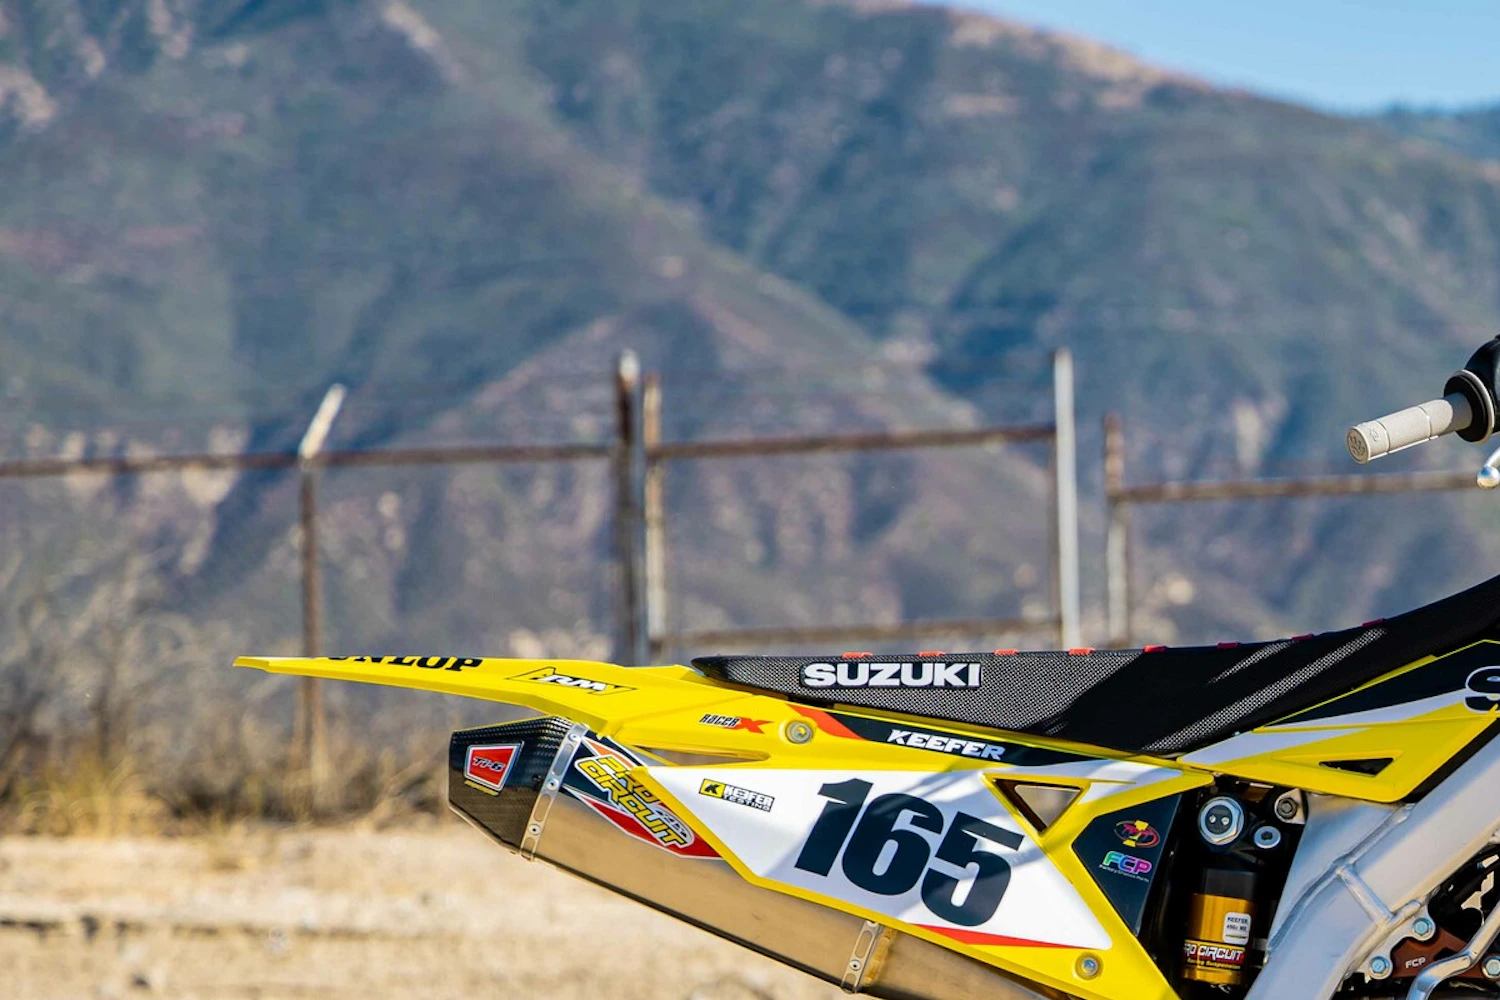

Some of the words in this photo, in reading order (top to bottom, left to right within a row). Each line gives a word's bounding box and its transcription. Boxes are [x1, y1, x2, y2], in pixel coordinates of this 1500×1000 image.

[804, 662, 981, 687] SUZUKI
[887, 730, 1006, 760] KEEFER
[600, 756, 661, 804] PRO
[579, 759, 687, 848] CIRCUIT
[724, 785, 773, 807] KEEFER
[794, 777, 1025, 927] 165
[1102, 851, 1153, 875] FCP
[1197, 946, 1244, 960] CIRCUIT
[1405, 957, 1426, 969] FCP
